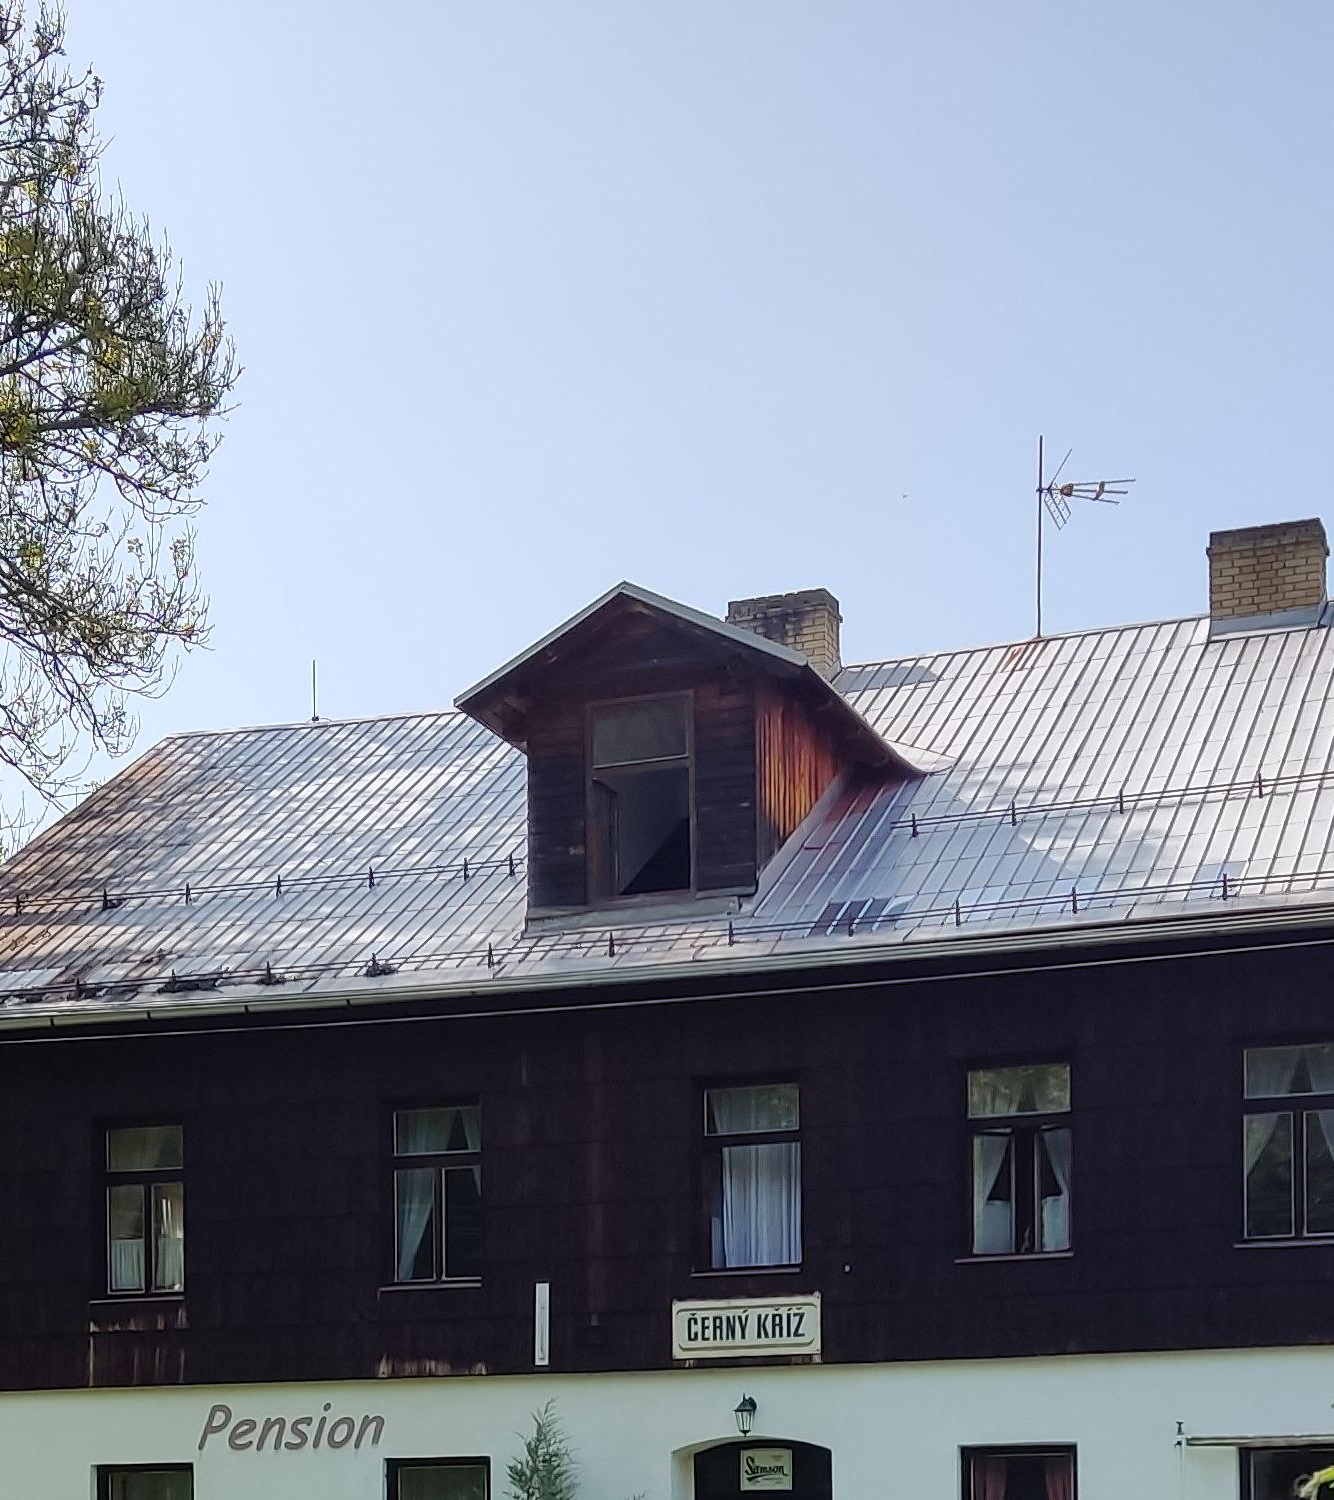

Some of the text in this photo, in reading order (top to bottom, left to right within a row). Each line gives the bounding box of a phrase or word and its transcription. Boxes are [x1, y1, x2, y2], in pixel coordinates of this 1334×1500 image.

[687, 1307, 806, 1342] ČERNÝ KŘÍŽ
[198, 1402, 385, 1451] Pension
[745, 1456, 788, 1477] Samson
